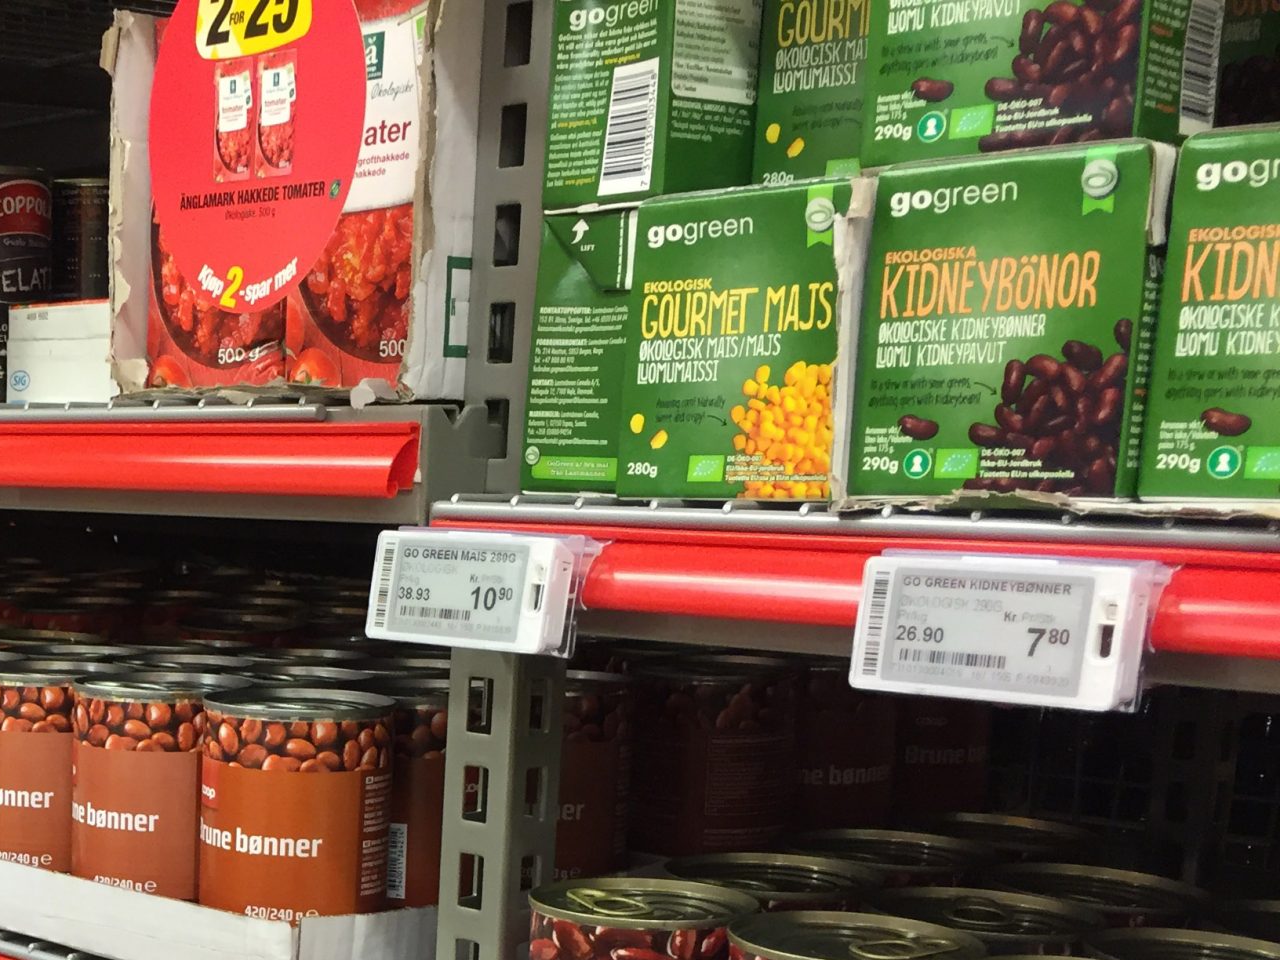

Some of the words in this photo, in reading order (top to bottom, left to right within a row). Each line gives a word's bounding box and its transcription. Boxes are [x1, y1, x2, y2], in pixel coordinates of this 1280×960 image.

[206, 0, 229, 46] 2
[229, 11, 244, 26] FOR
[244, 0, 299, 39] 25
[569, 0, 658, 31] gogreen
[887, 9, 925, 35] LUOMU
[775, 41, 841, 71] ØKOLOGISK
[772, 62, 858, 94] LUOMUMAISSI
[364, 119, 412, 146] ater
[874, 124, 912, 142] 290g
[1196, 157, 1280, 191] gogr
[237, 186, 279, 205] HAKKEDE
[283, 182, 325, 199] TOMATER
[890, 180, 1018, 217] gogreen
[647, 215, 753, 249] gogreen
[1188, 225, 1280, 243] EKOLOGISK
[580, 243, 595, 251] LIFT
[885, 246, 977, 265] EKOLOGISKA
[220, 266, 244, 309] 2
[274, 257, 298, 288] mer
[644, 278, 713, 294] EKOLOGISK
[880, 250, 1101, 320] KIDNEYBÖNOR
[641, 288, 759, 339] GOURMET
[763, 282, 833, 333] MAJS
[1178, 302, 1266, 331] ØKOLOGISKE
[878, 317, 948, 345] ØKOLOGISKE
[951, 314, 1046, 339] KIDNEYBØNNER
[639, 337, 705, 362] ØKOLOGISK
[706, 333, 782, 360] MAIS/MAJS
[876, 344, 911, 369] LUOMU
[916, 340, 1007, 367] KIDNEYPAVUT
[1175, 331, 1220, 358] LUOMU
[637, 359, 719, 385] LUOMUMAISSI
[627, 461, 658, 478] 280g
[861, 457, 899, 474] 290g
[1156, 453, 1201, 474] 290g
[404, 548, 419, 558] GO
[422, 549, 458, 561] GREEN
[461, 551, 487, 562] MAIS
[398, 586, 430, 601] 38.93
[903, 577, 921, 587] GO
[925, 577, 966, 589] GREEN
[970, 578, 1072, 595] KIDNEYBØNNER
[896, 625, 944, 643] 26.90
[1027, 627, 1047, 657] 7
[87, 802, 160, 832] bønner
[236, 827, 323, 858] bønner
[244, 905, 294, 922] 420/240
